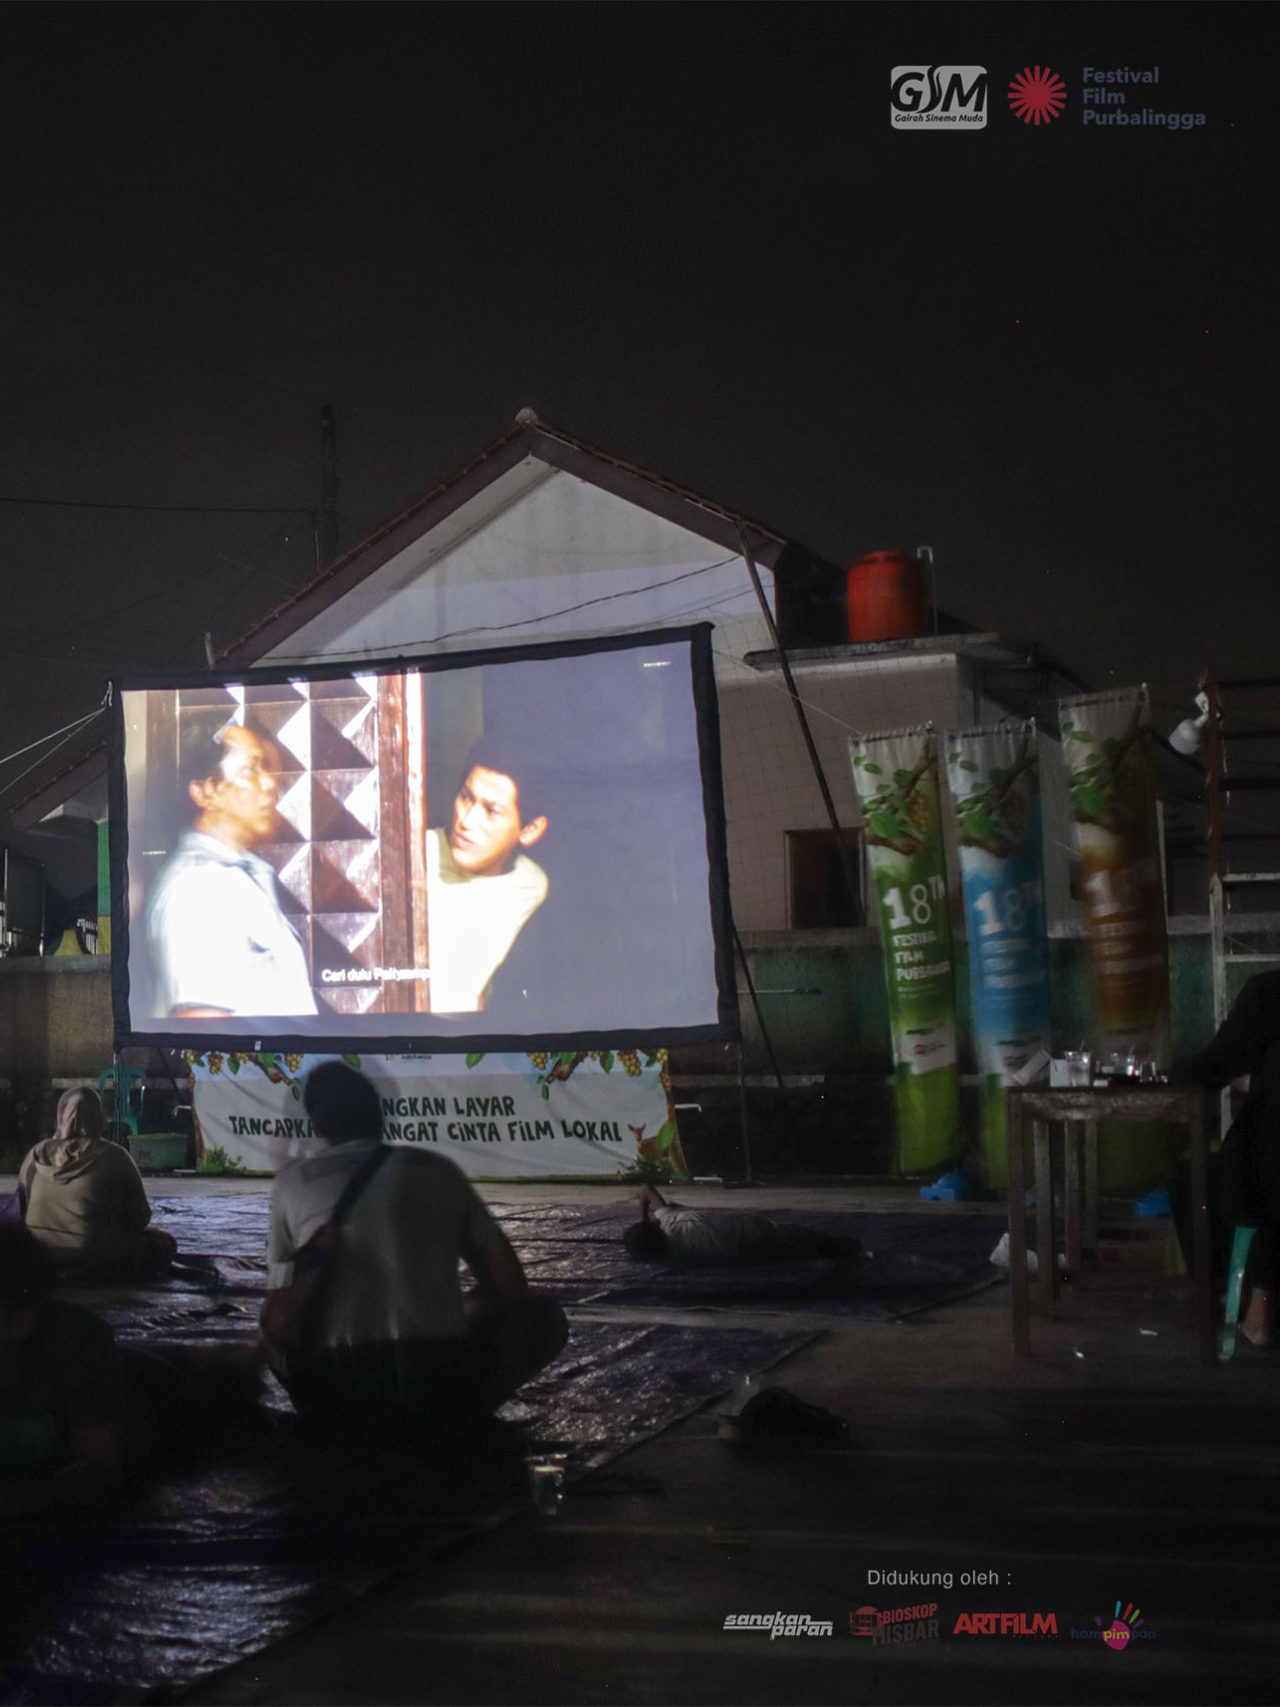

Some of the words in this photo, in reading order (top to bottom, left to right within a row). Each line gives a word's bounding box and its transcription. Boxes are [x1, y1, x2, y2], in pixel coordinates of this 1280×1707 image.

[322, 969, 345, 983] Cari
[382, 1097, 446, 1117] NGKAN
[453, 1096, 515, 1117] LAYAR
[228, 1115, 318, 1138] TANCAPKA
[560, 1119, 623, 1142] LOKAL
